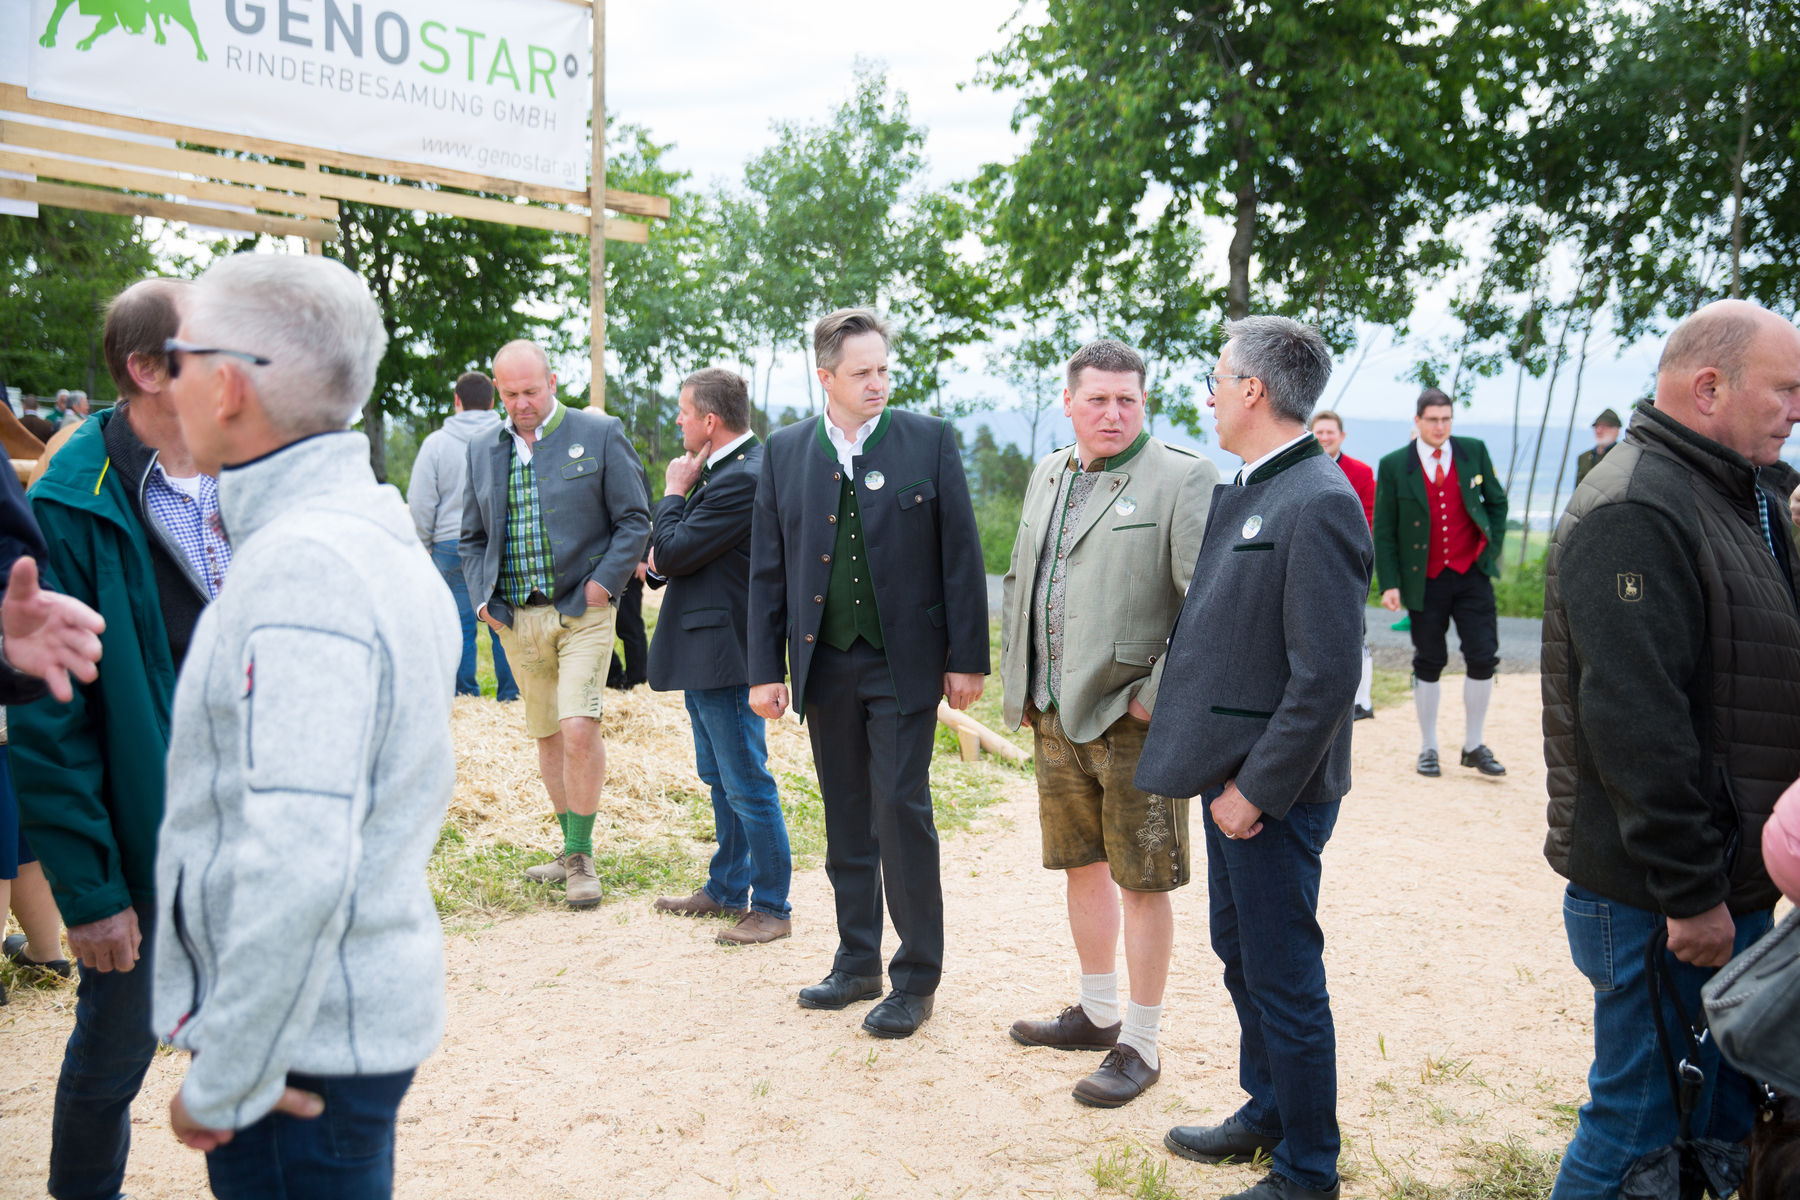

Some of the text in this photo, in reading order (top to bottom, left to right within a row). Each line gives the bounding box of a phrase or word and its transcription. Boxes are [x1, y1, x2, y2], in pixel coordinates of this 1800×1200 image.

[225, 0, 557, 99] GENOSTAR
[226, 45, 557, 132] RINDERBESAMUNG GMBH
